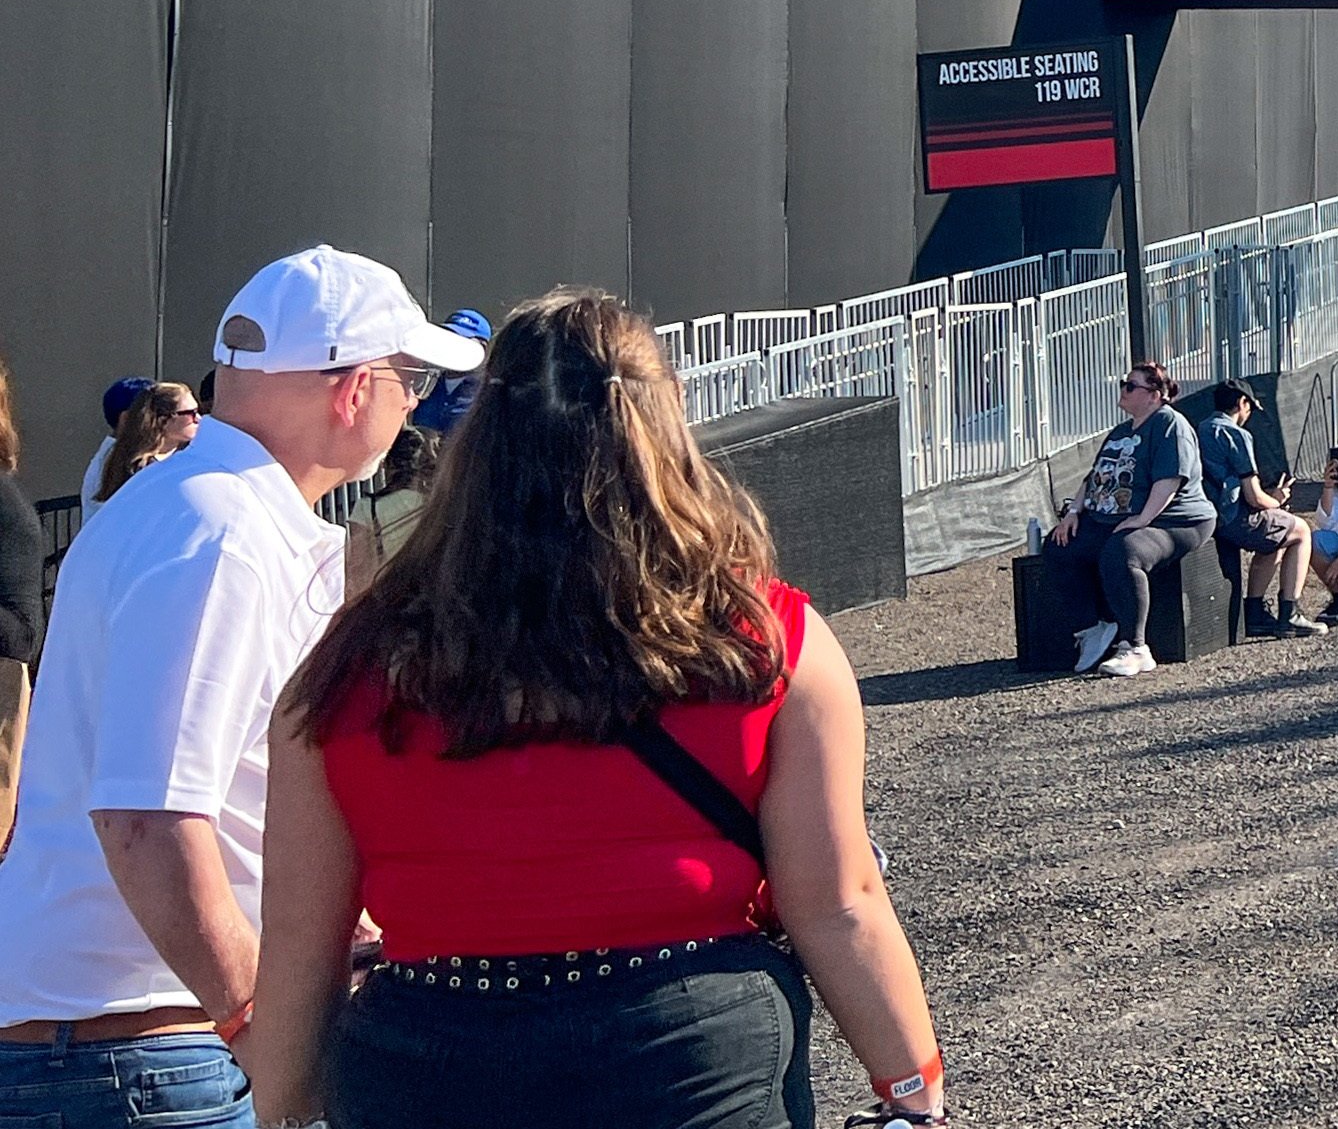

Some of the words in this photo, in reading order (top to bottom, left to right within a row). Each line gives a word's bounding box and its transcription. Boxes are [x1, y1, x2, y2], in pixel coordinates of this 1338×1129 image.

[939, 56, 1031, 85] ACCESSIBLE
[1034, 50, 1099, 77] SEATING
[1035, 80, 1062, 102] 119
[1064, 76, 1100, 100] WCR
[894, 1077, 922, 1096] FLOOR
